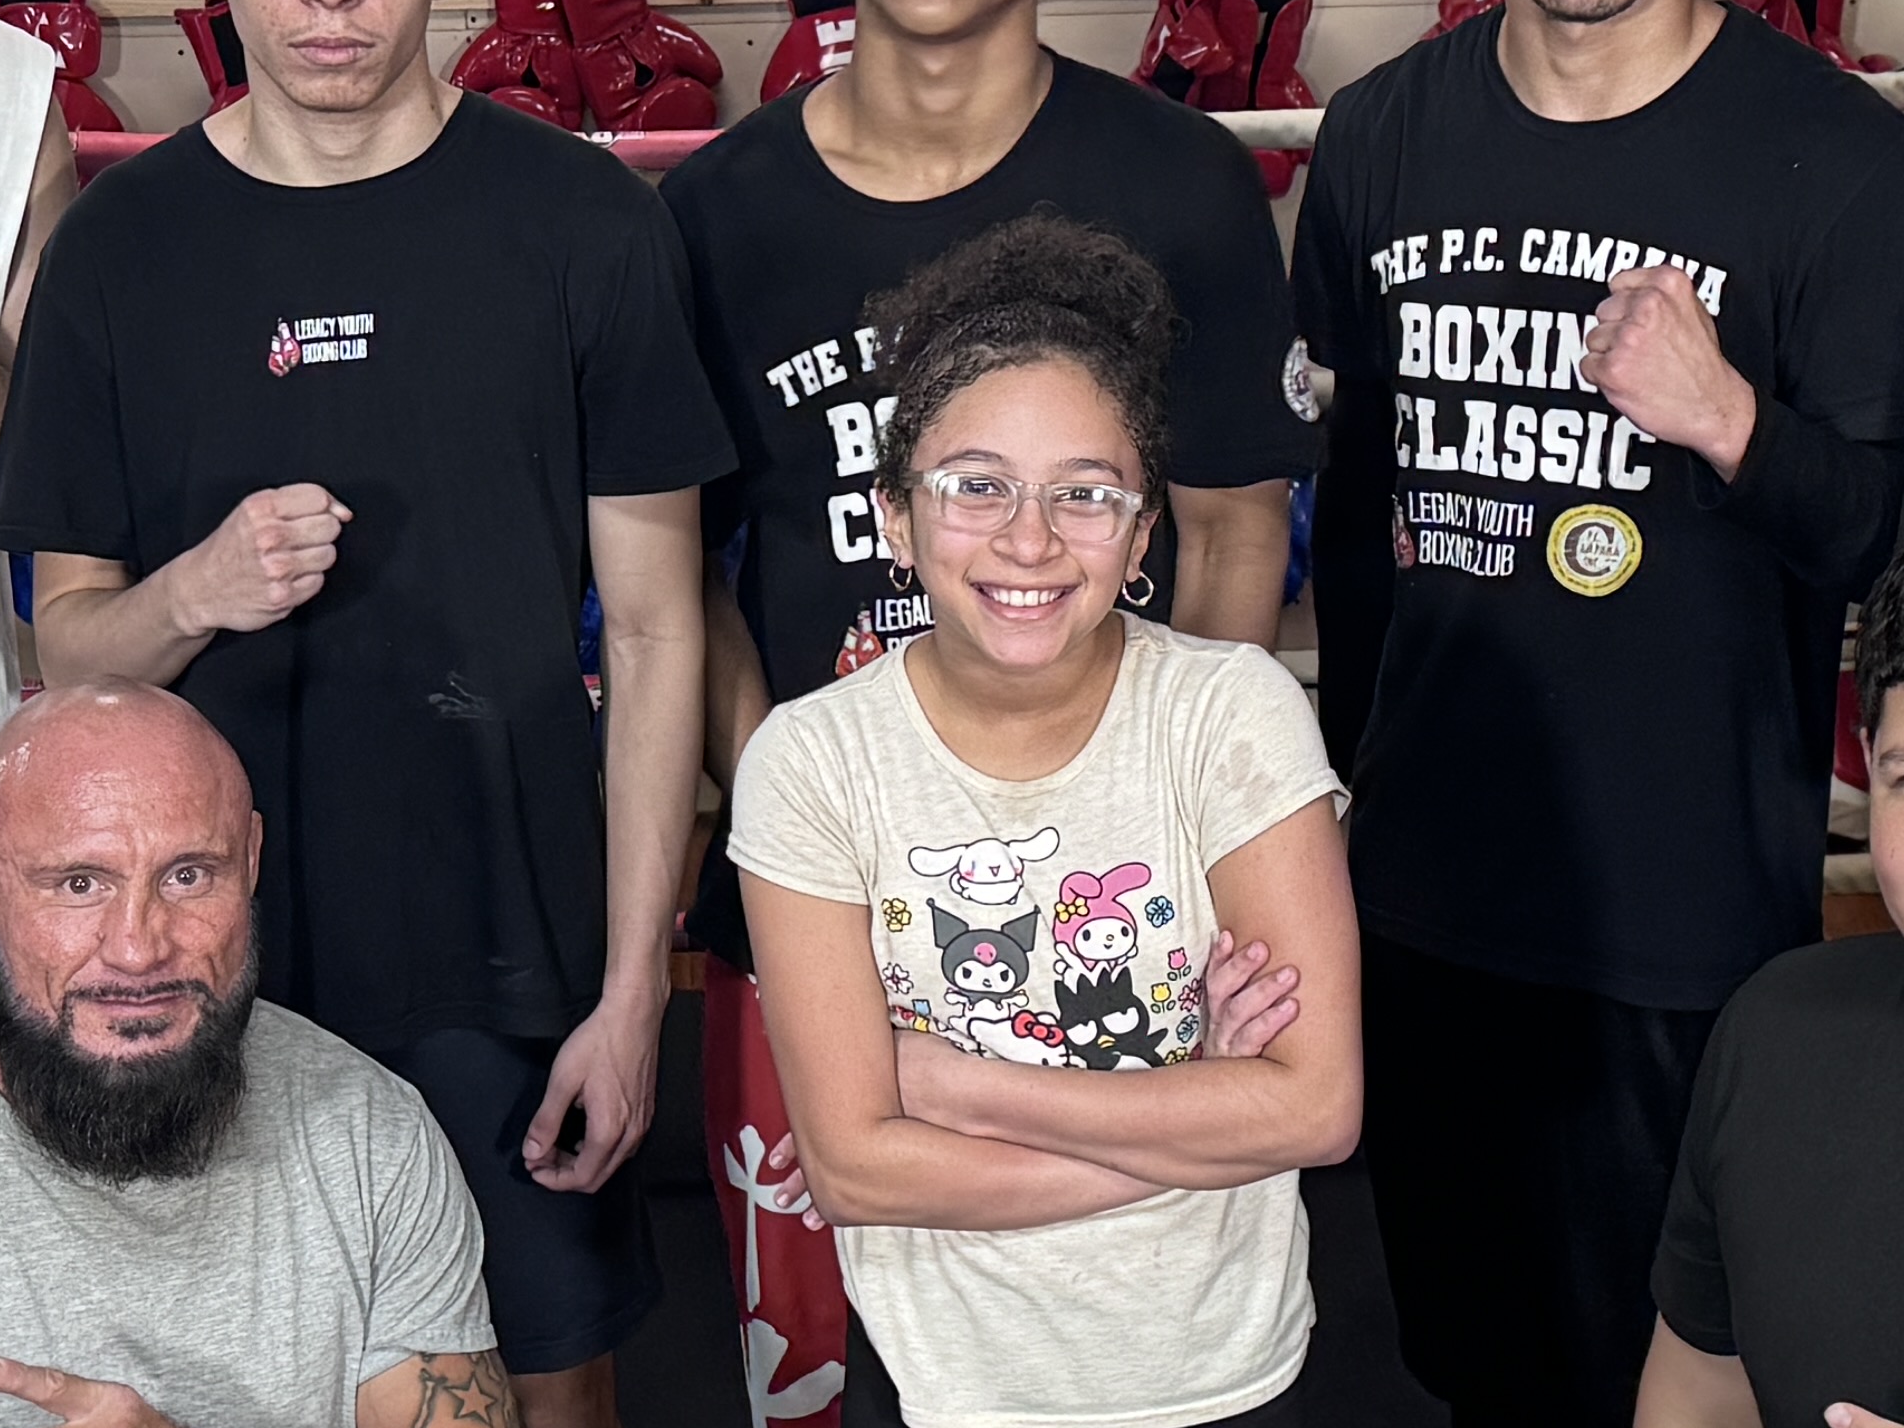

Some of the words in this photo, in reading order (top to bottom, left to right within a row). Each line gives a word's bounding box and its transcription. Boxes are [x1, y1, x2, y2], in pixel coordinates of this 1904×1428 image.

[1371, 234, 1428, 296] THE
[1441, 227, 1505, 274] P.C.
[337, 313, 374, 336] YOUTH
[1399, 302, 1599, 395] BOXIN
[766, 339, 848, 407] THE
[1396, 393, 1656, 492] CLASSIC
[1408, 490, 1473, 529] LEGACY
[1476, 497, 1535, 538] YOUTH
